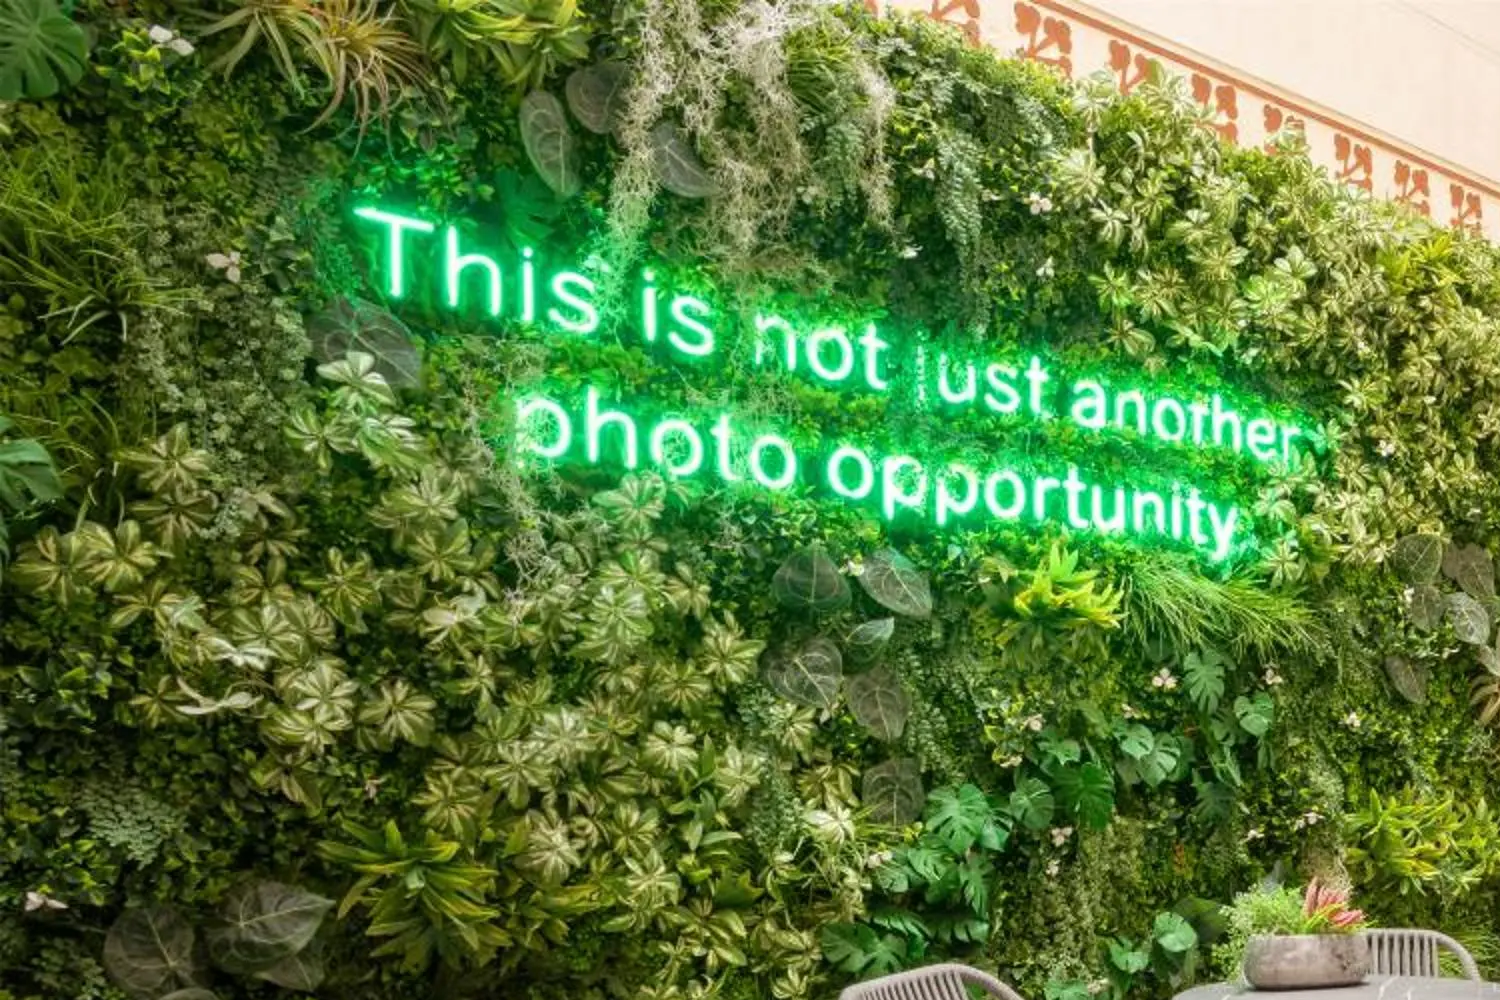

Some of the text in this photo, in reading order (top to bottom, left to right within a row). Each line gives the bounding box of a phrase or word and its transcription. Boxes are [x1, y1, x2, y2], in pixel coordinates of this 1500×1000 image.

[353, 206, 600, 334] This
[641, 270, 715, 356] is
[754, 312, 889, 390] not
[1071, 377, 1302, 474] another
[515, 384, 1239, 562] photo opportunity
